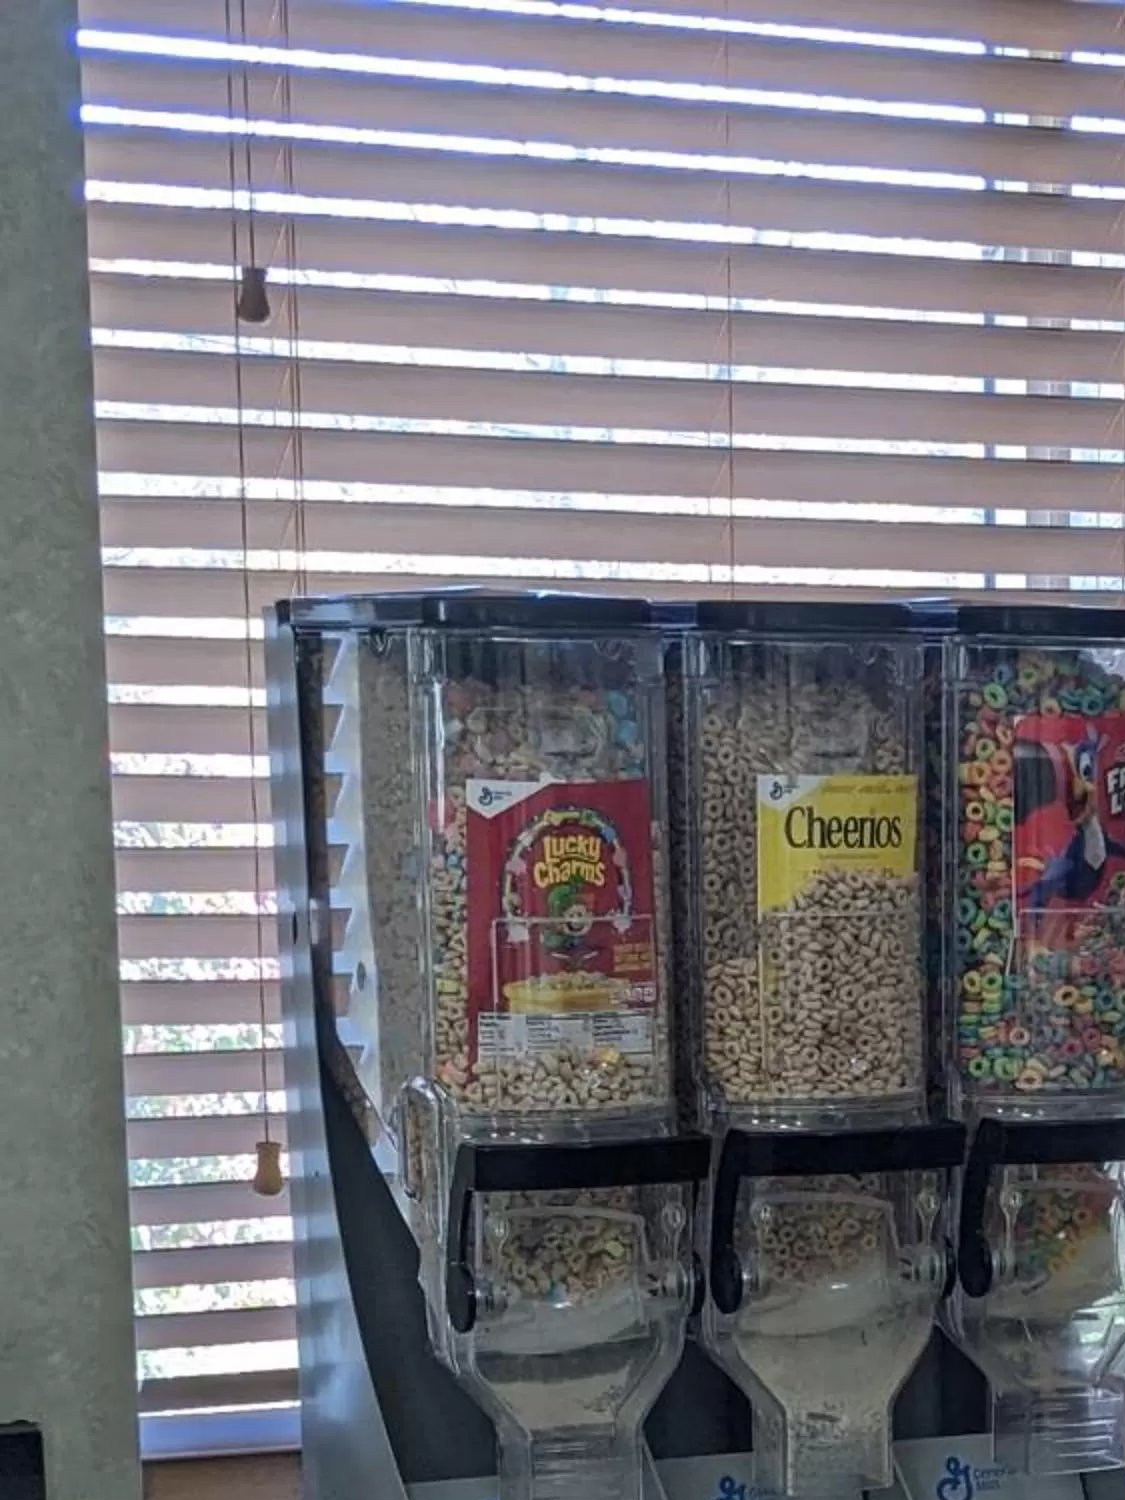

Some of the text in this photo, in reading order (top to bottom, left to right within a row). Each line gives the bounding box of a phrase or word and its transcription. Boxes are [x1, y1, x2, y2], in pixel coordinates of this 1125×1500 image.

[784, 805, 902, 849] Cheerios
[543, 834, 602, 865] Lucky
[533, 858, 606, 889] Charms
